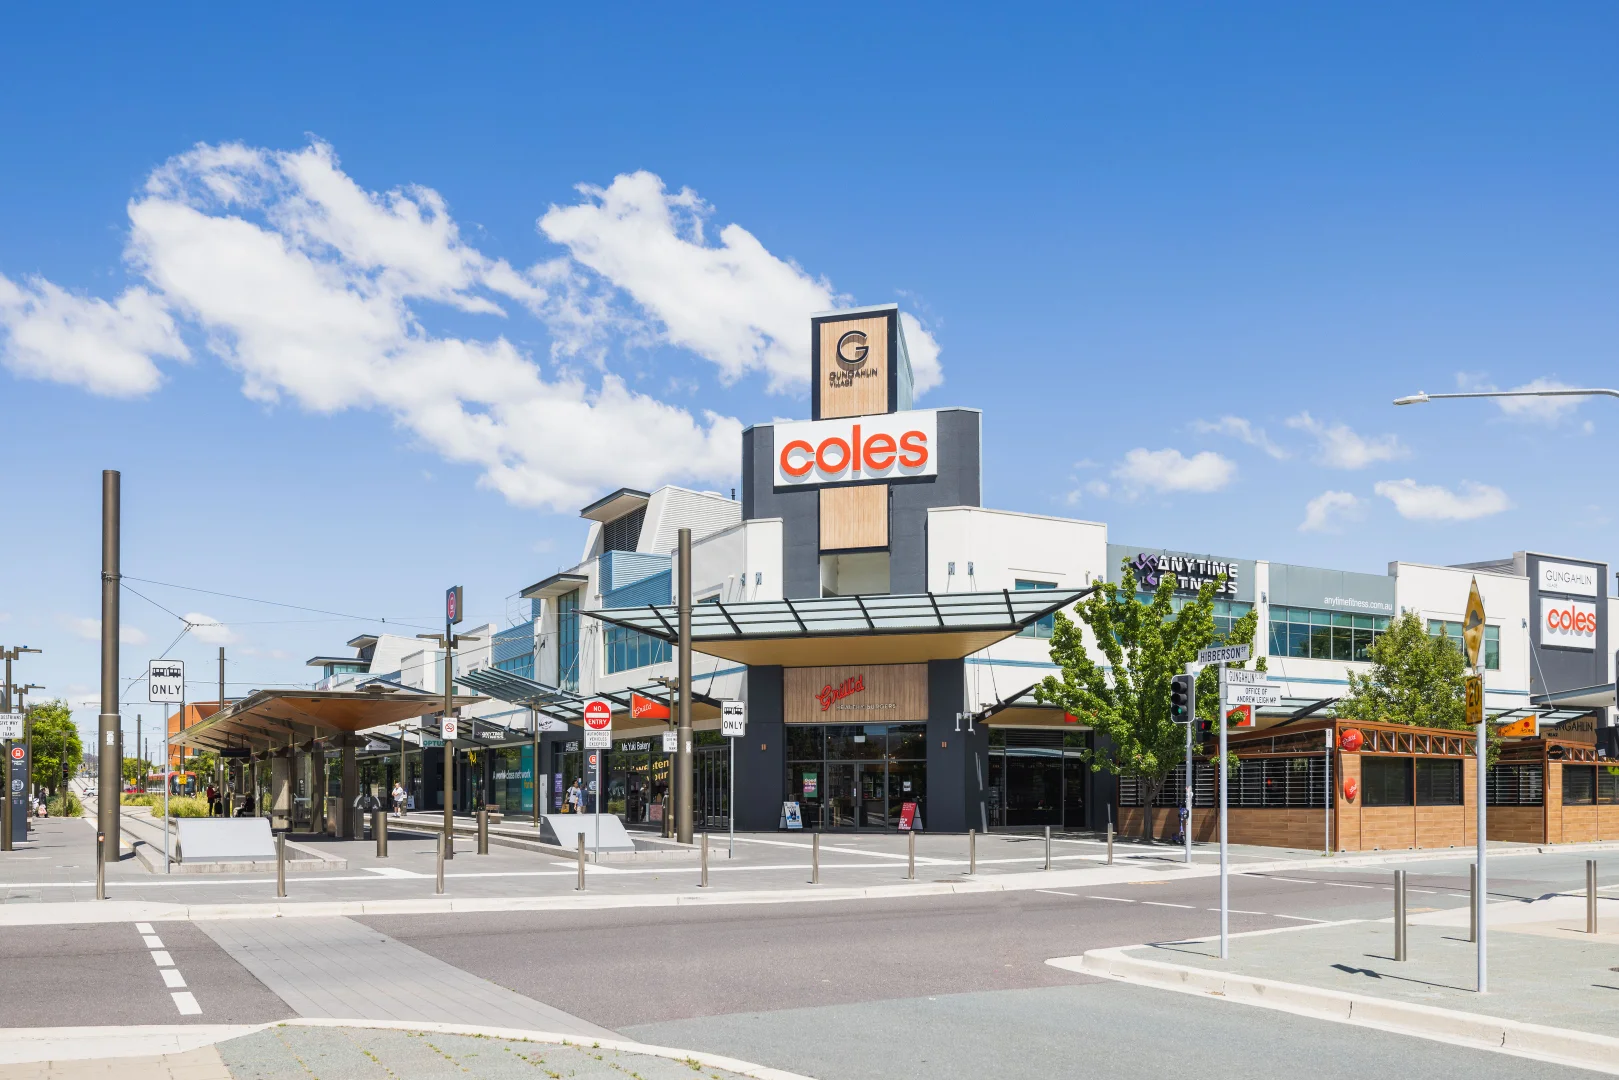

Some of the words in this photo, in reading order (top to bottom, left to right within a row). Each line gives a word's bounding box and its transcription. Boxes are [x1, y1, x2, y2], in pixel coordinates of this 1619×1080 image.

[829, 368, 878, 381] GUNGAHLIN
[780, 424, 928, 477] coles
[1157, 554, 1239, 578] ANYTIME
[1545, 569, 1593, 585] GUNGAHLIN
[1324, 596, 1393, 611] anytimefitness.com.au
[1547, 605, 1597, 633] coles
[1200, 647, 1240, 663] HIBBERSON
[152, 684, 181, 695] ONLY
[815, 674, 865, 712] Grill'd
[1245, 687, 1260, 695] OFFICE
[1261, 688, 1268, 696] OF
[1468, 680, 1480, 708] 20
[1256, 696, 1269, 704] LEIGH
[724, 720, 743, 730] ONLY
